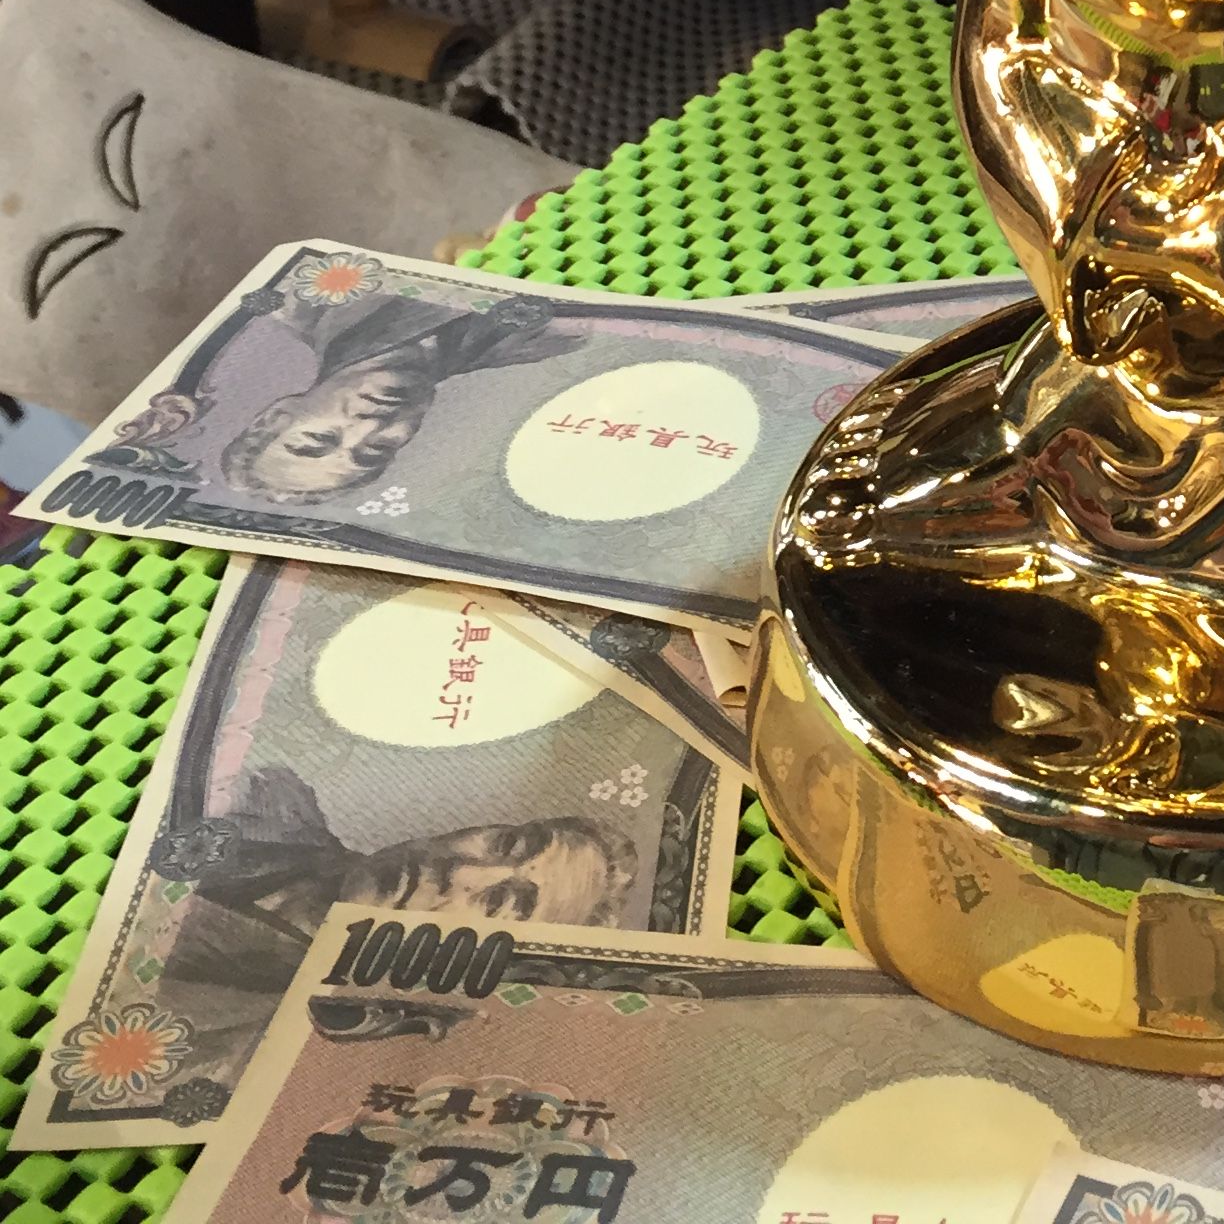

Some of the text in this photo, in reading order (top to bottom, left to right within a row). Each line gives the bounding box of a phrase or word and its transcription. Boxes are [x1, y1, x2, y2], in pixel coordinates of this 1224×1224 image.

[547, 415, 739, 460] 玩具銀行
[41, 470, 200, 530] 10000
[320, 918, 515, 998] 10000
[361, 1082, 616, 1136] 玩具銀行
